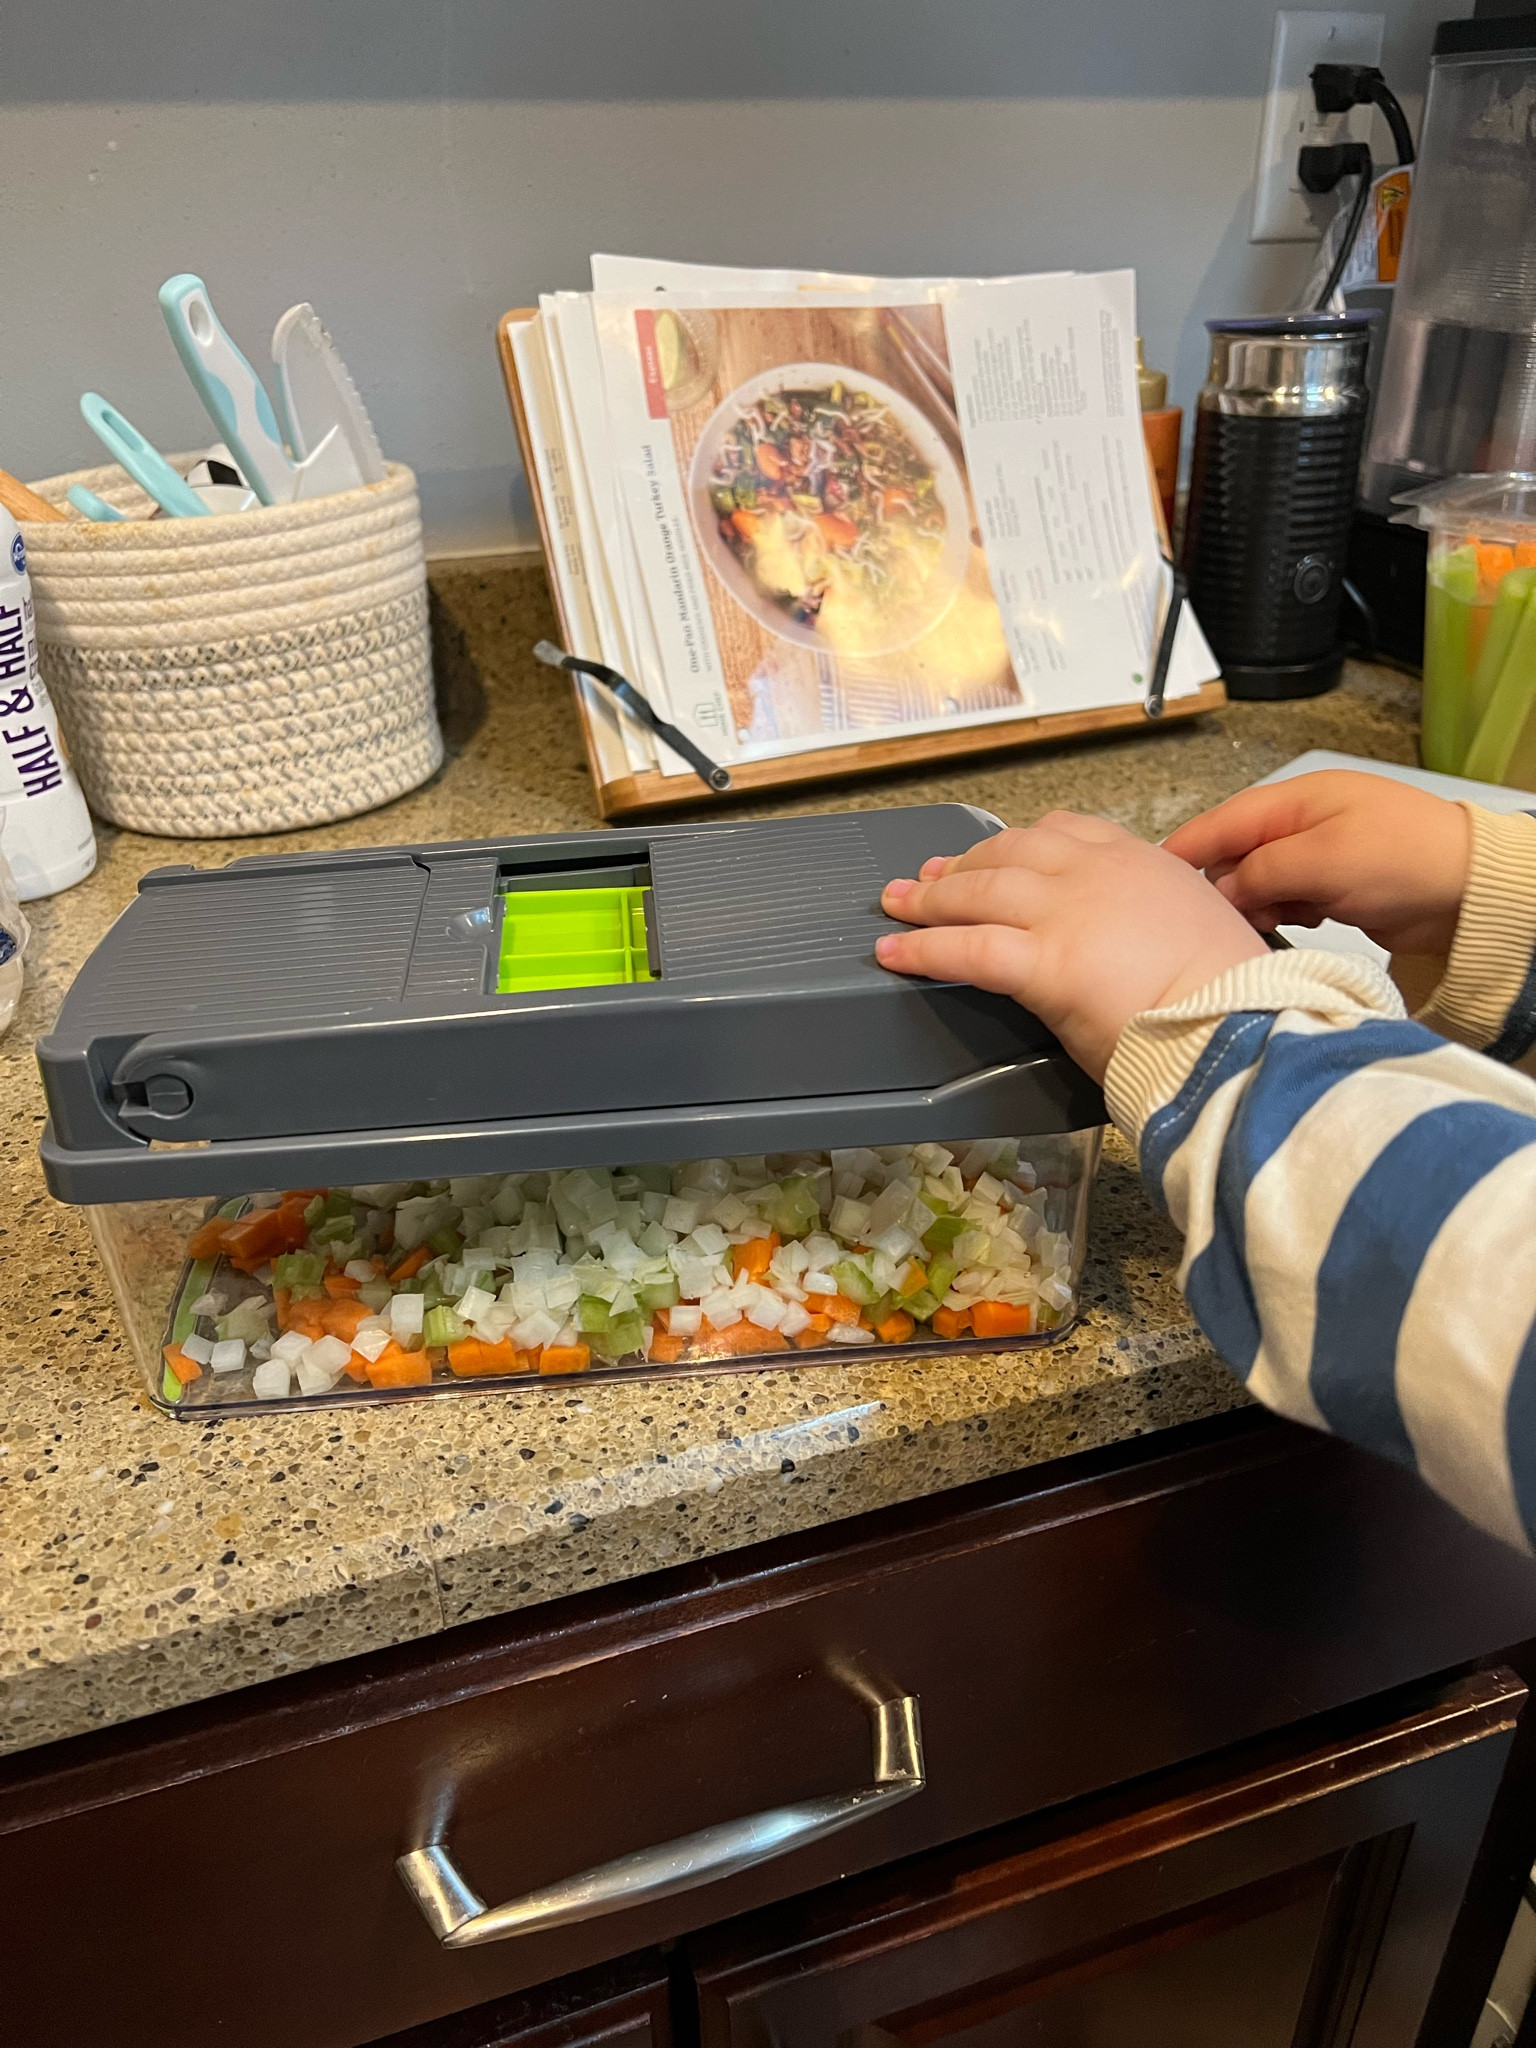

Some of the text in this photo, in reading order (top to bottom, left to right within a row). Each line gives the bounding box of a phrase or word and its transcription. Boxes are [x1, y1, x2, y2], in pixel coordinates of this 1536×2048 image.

[641, 444, 656, 477] Salad
[649, 480, 666, 521] Turkey
[659, 523, 676, 564] Orange
[669, 566, 690, 621] Mandarin
[0, 605, 27, 681] HALF
[0, 684, 35, 716] &
[2, 725, 63, 797] HALF
